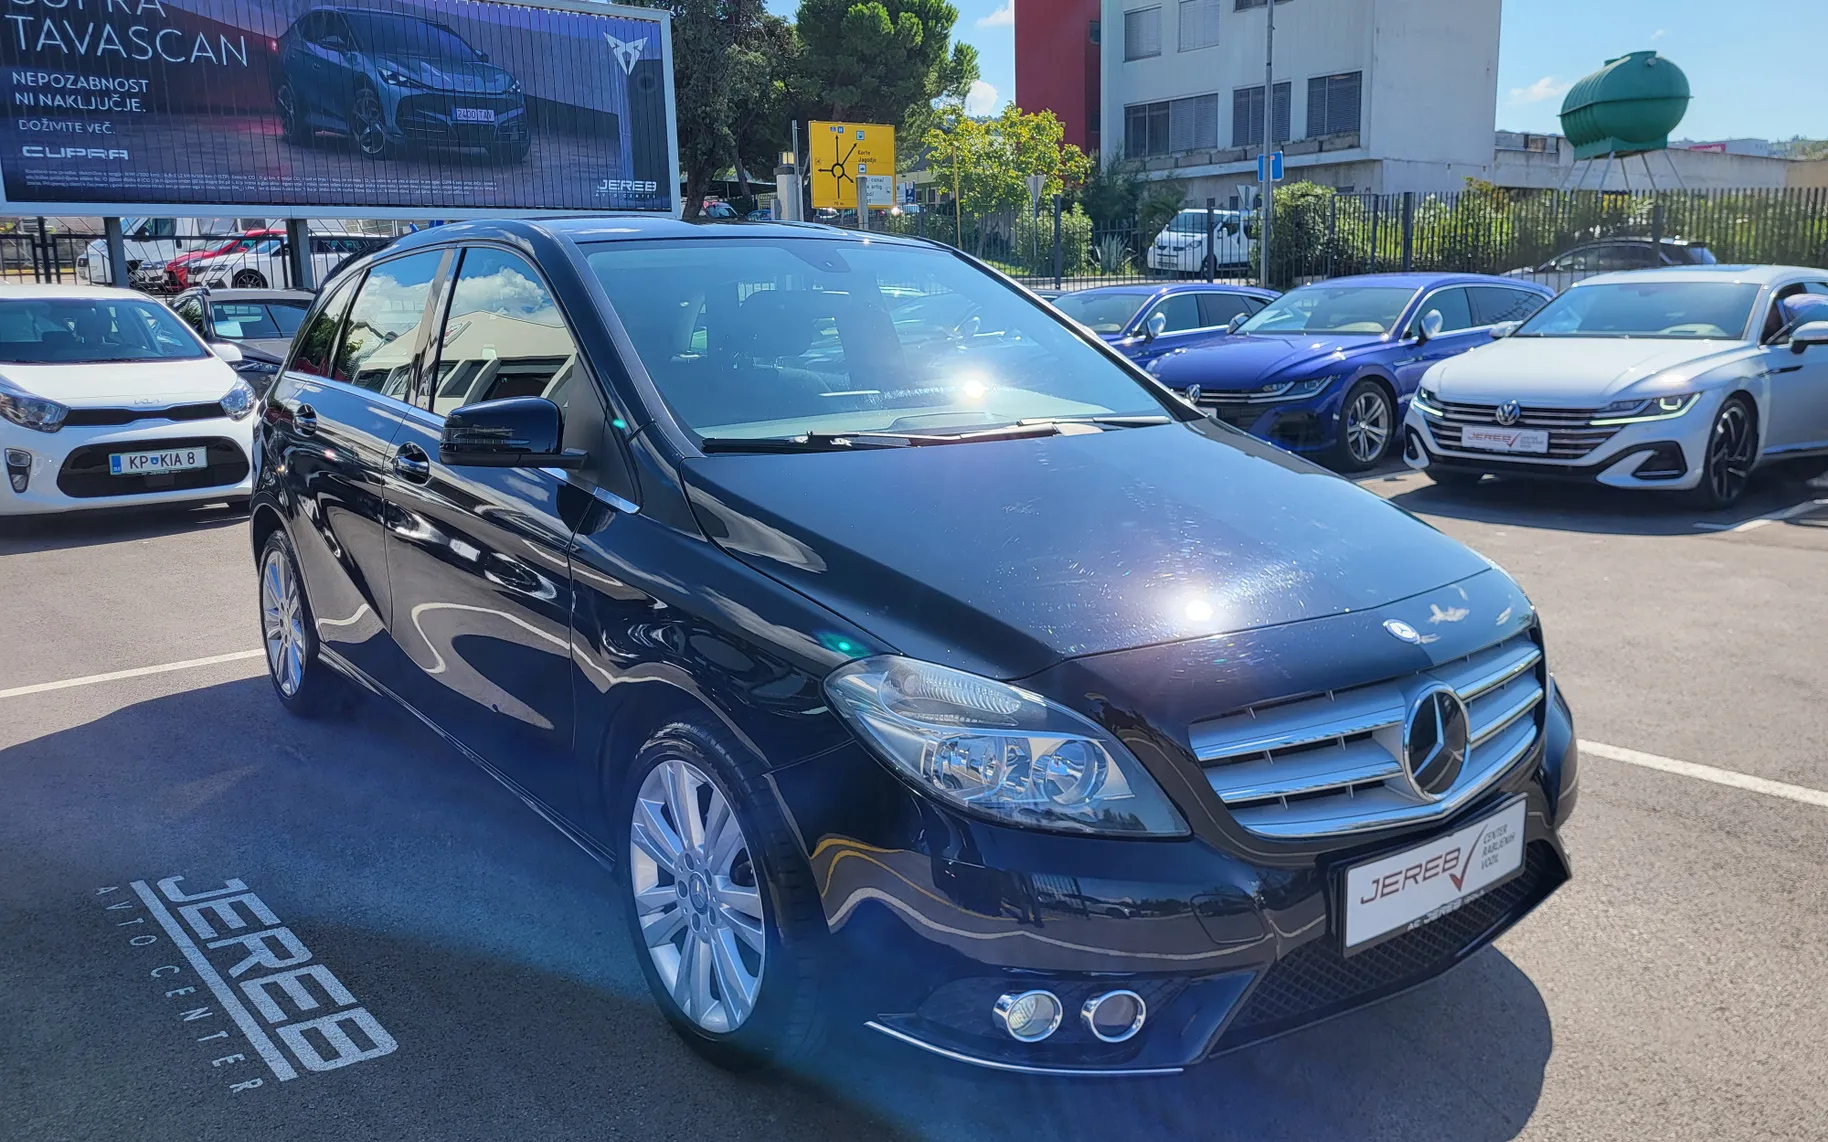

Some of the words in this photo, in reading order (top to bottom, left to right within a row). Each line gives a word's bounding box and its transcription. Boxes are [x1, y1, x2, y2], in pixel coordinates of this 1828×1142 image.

[5, 14, 249, 67] TAVASCAN
[12, 71, 149, 92] NEPOZABNOST
[15, 92, 34, 105] NI
[39, 93, 147, 112] NAKLJUČJE.
[18, 118, 83, 133] DOŽIVITE
[86, 122, 116, 134] VEČ.
[22, 146, 129, 160] CUPRA
[597, 180, 657, 191] JEREB
[129, 455, 149, 469] KP
[160, 453, 183, 467] KIA
[187, 451, 195, 465] 8
[1360, 846, 1461, 905] JEREB
[156, 875, 399, 1072] JEREB
[96, 885, 158, 946] AVTO
[150, 965, 264, 1094] CENTER
